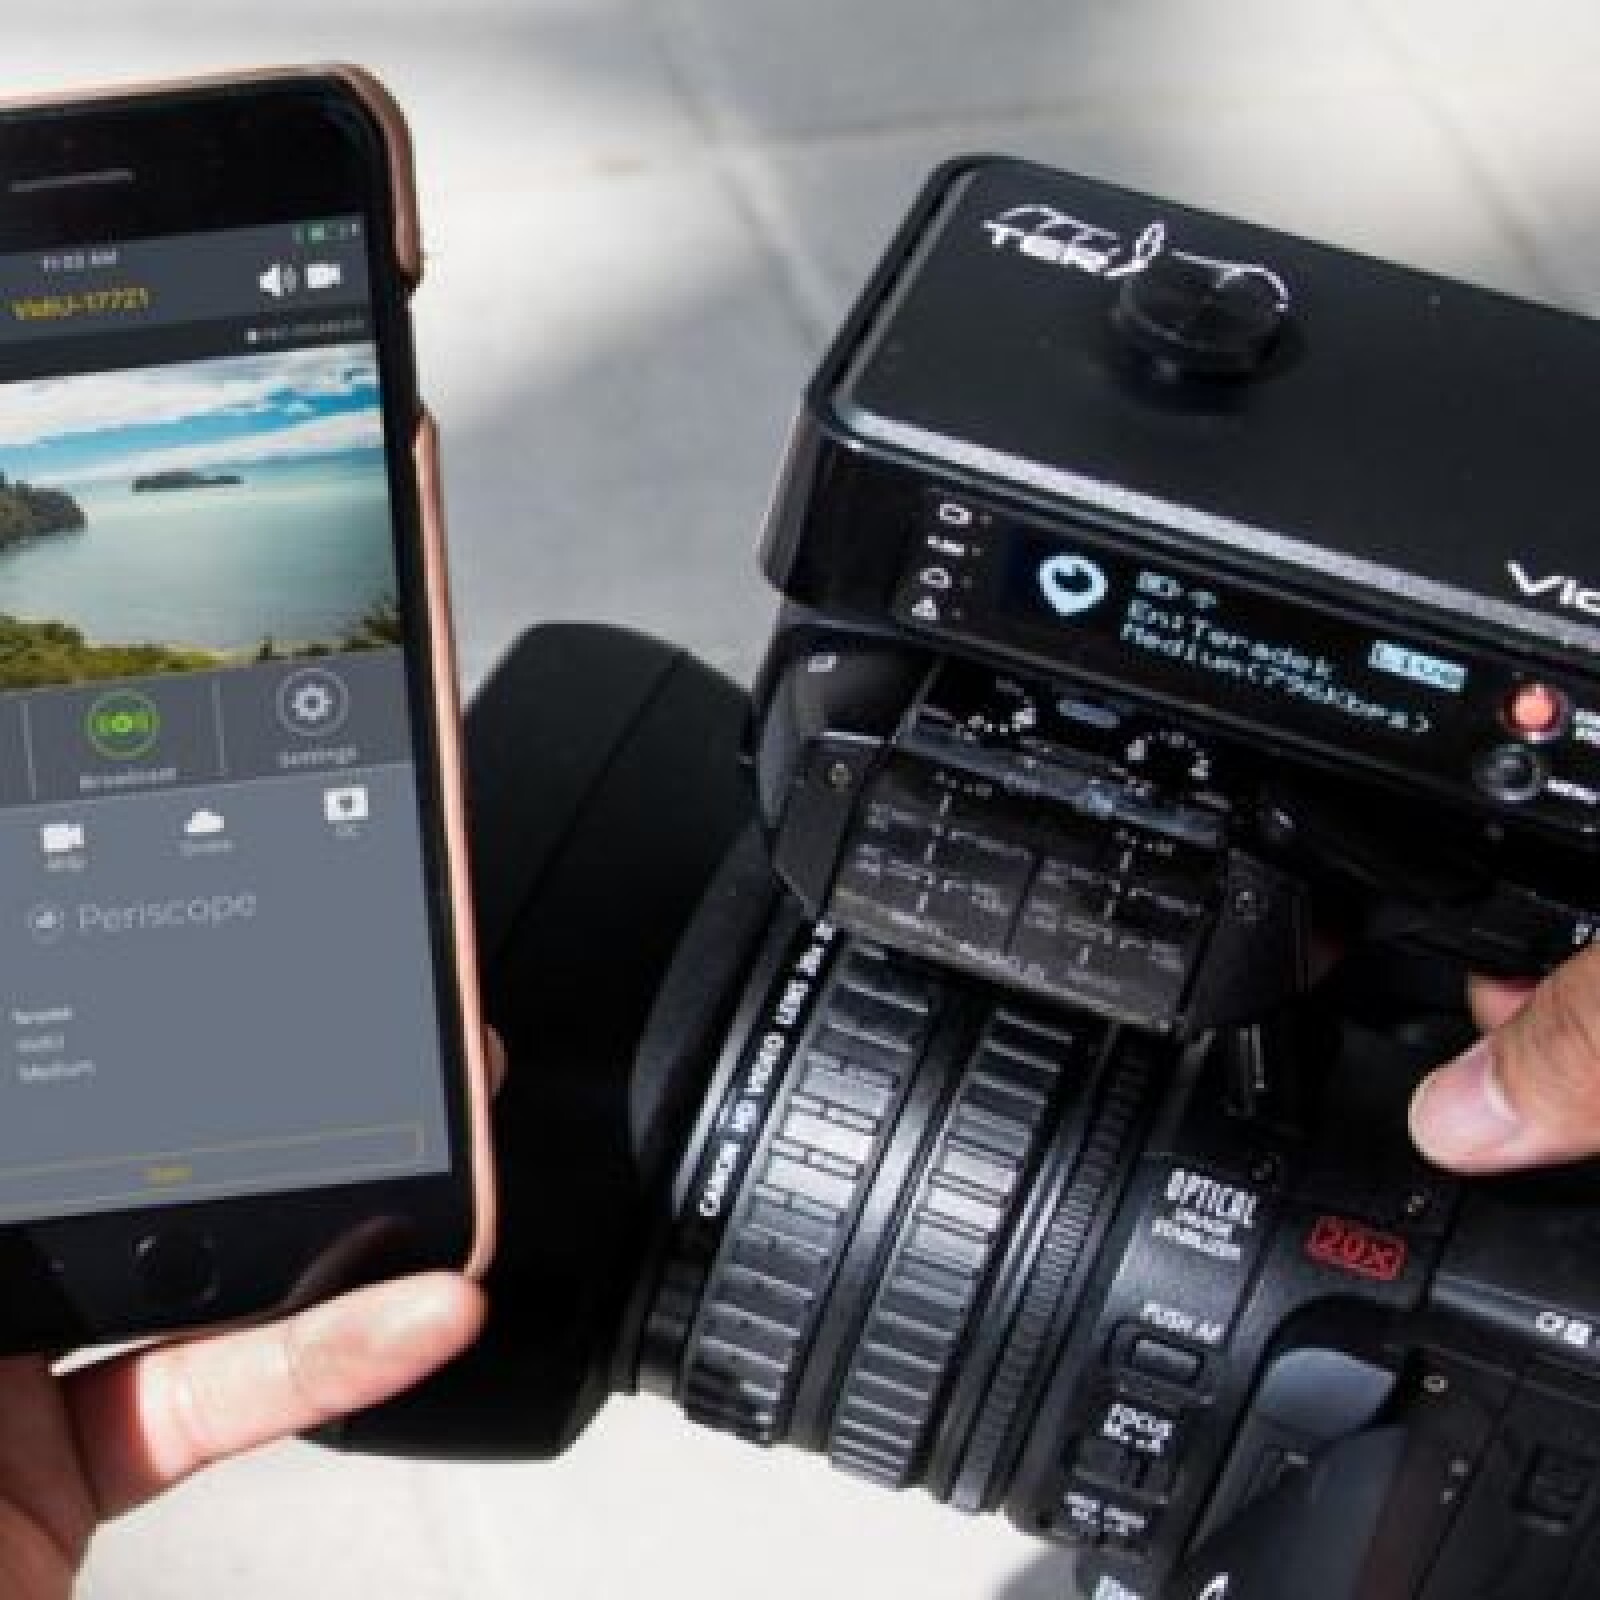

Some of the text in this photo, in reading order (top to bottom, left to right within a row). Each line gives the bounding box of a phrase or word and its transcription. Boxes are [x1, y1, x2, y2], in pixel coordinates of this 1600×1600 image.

[78, 893, 257, 932] Periscope
[699, 1141, 741, 1217] CANON
[746, 1034, 786, 1093] VIDEO
[1166, 1166, 1259, 1229] OPTICAL
